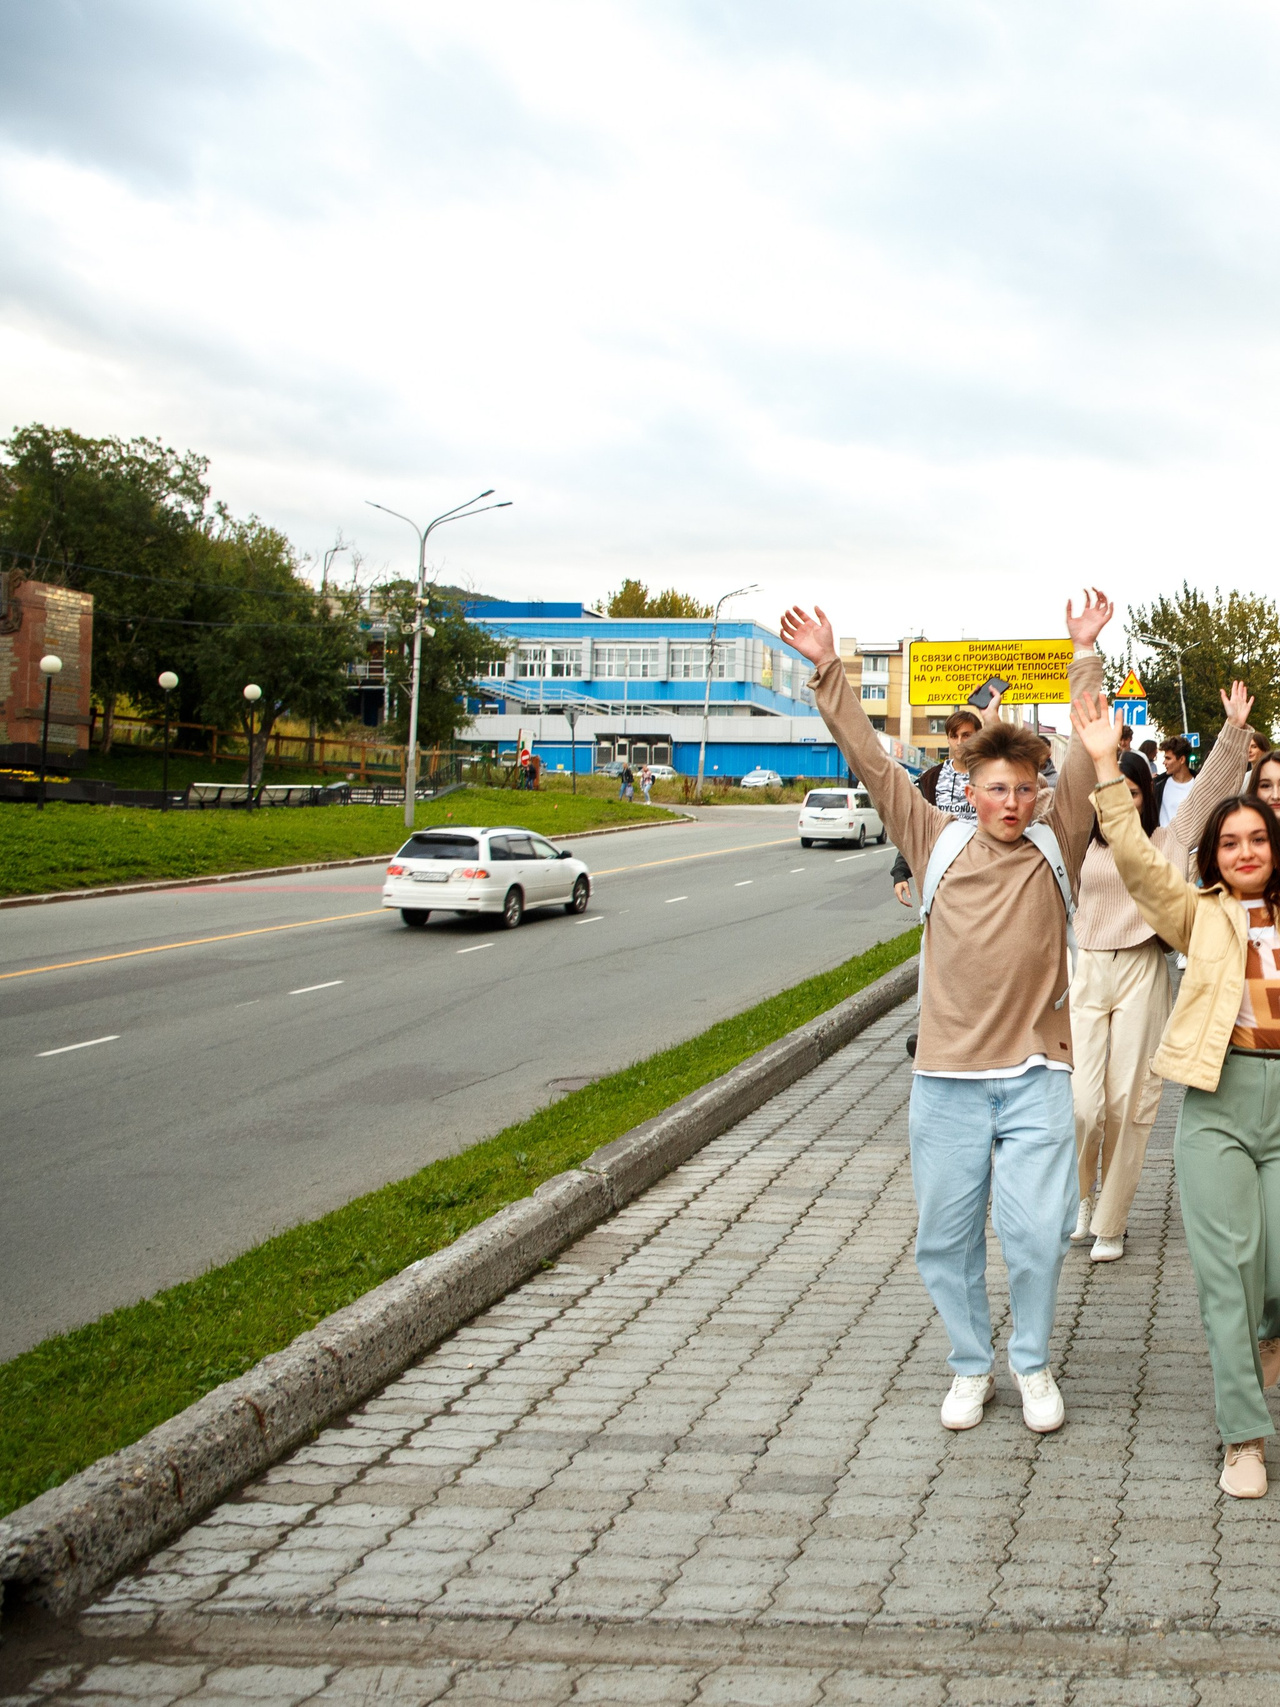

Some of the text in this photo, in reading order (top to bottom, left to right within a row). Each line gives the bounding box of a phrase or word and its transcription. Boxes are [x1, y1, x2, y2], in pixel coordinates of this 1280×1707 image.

[968, 643, 1023, 652] ВНИМАНИЕ!
[921, 654, 952, 662] СВЯЗИ
[963, 652, 1046, 662] ПРОИЗВОДСТВОМ
[1048, 652, 1074, 660] РАБО
[920, 664, 933, 672] ПО
[936, 663, 1014, 672] РЕКОНСТРУКЦИИ
[914, 674, 927, 682] НА
[930, 675, 943, 684] ул.
[1006, 674, 1019, 683] ул.
[1012, 692, 1065, 701] ДВИЖЕНИЕ
